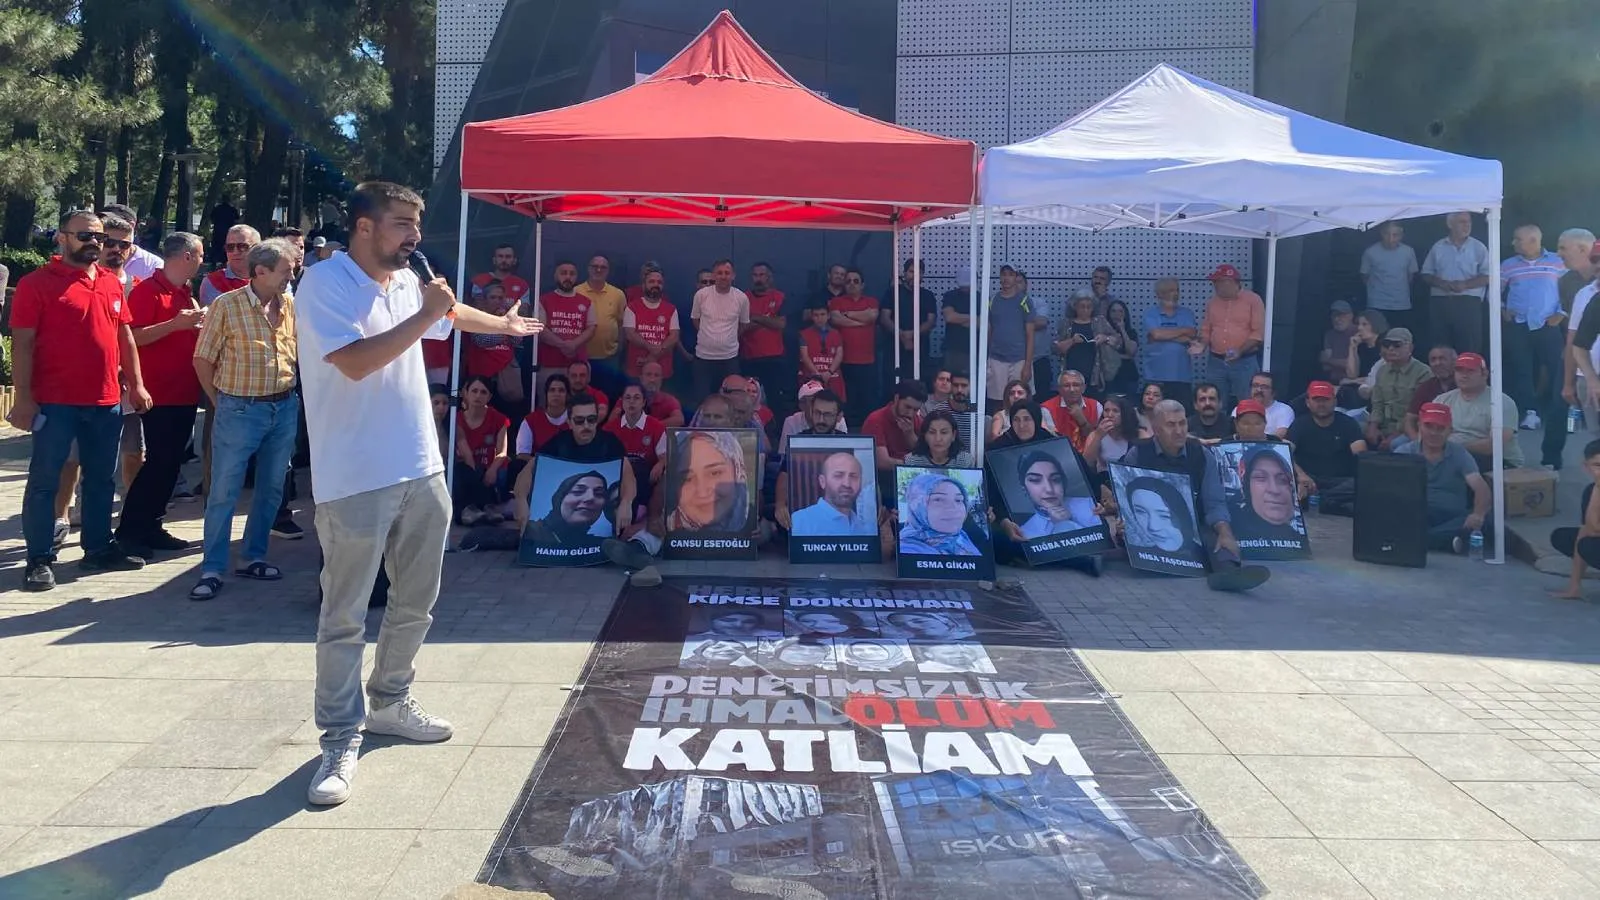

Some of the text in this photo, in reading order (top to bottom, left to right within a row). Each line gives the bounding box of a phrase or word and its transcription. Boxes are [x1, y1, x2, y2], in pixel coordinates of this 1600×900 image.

[670, 537, 750, 548] CANSU ESETOĞLU
[802, 543, 869, 552] TUNCAY YILDIZ
[1030, 532, 1105, 553] TUĞBA TAŞDEMİR
[1269, 539, 1302, 549] YILMAZ
[535, 545, 601, 557] HANIM GÜLEK
[916, 560, 944, 569] ESMA
[1138, 552, 1204, 569] NİSA TAŞDEMİR
[789, 597, 974, 610] DOKUNMADI
[649, 675, 1039, 699] DENETİMSİZLİK
[844, 691, 1057, 729] ÖLÜM
[622, 723, 1095, 776] KATLİAM
